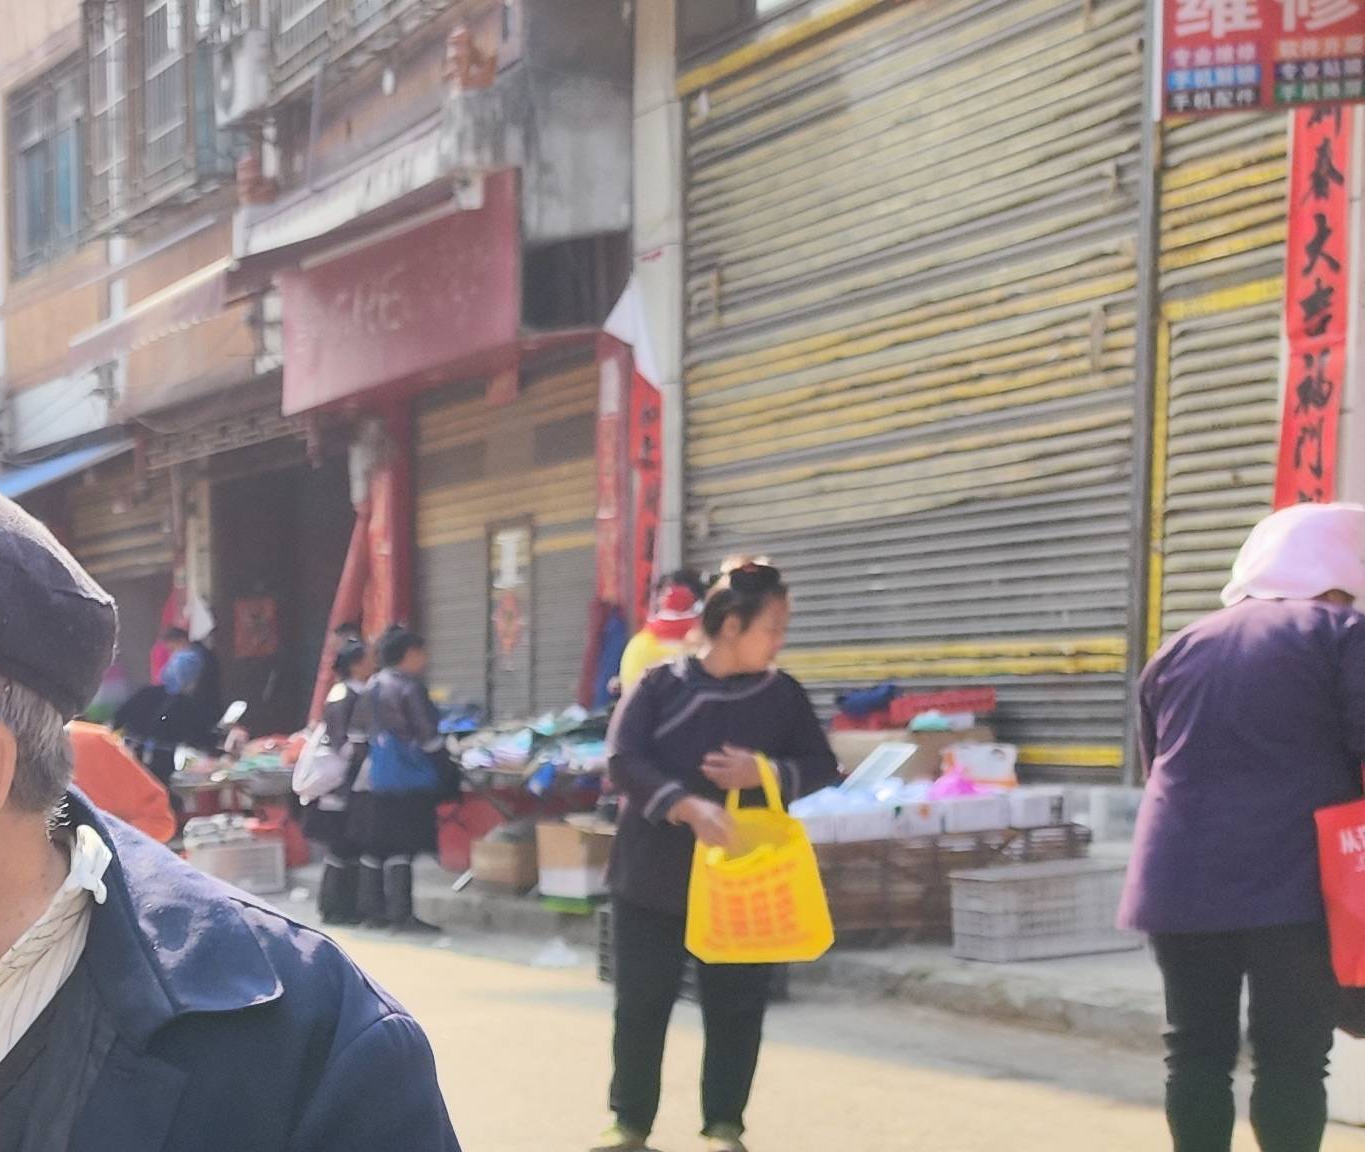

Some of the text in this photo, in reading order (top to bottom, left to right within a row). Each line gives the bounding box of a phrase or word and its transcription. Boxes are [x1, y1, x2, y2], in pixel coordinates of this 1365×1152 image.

[1292, 107, 1344, 502] 春大吉福门
